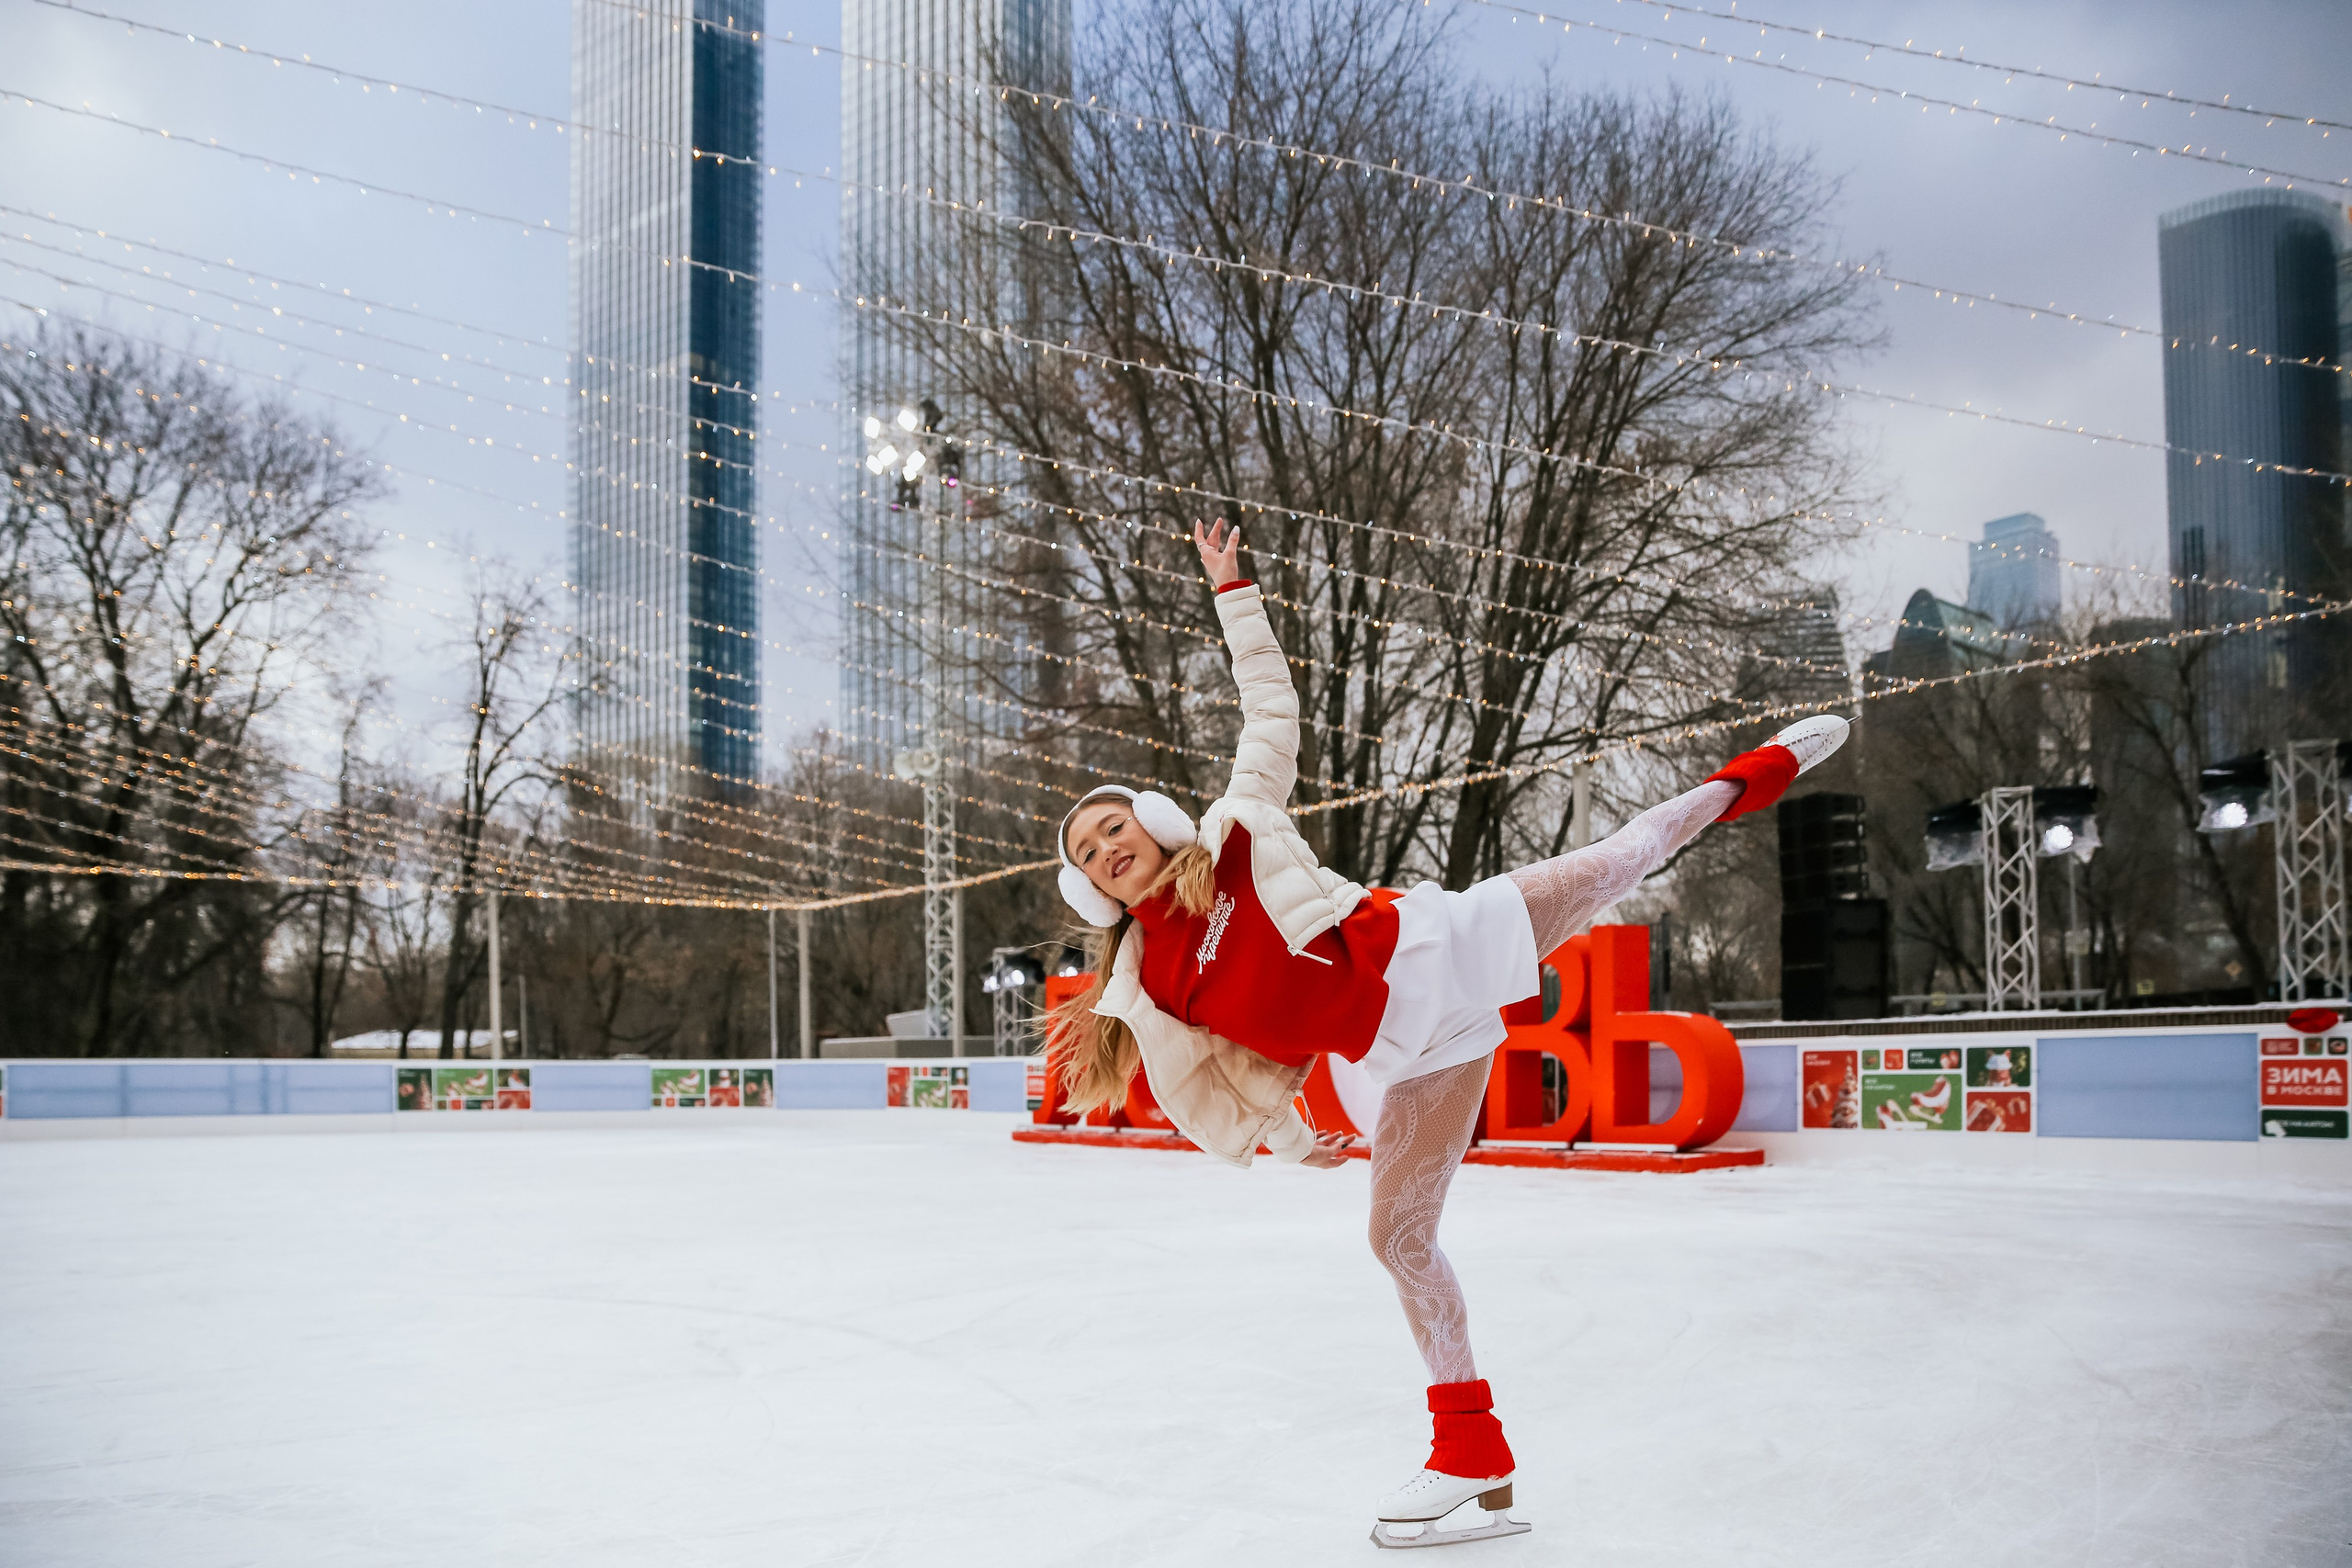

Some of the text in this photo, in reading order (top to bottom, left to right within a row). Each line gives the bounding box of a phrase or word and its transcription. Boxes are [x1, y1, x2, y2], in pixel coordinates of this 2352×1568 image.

[2266, 1066, 2343, 1084] ЗИМА
[2266, 1085, 2344, 1097] В МОСКВЕ
